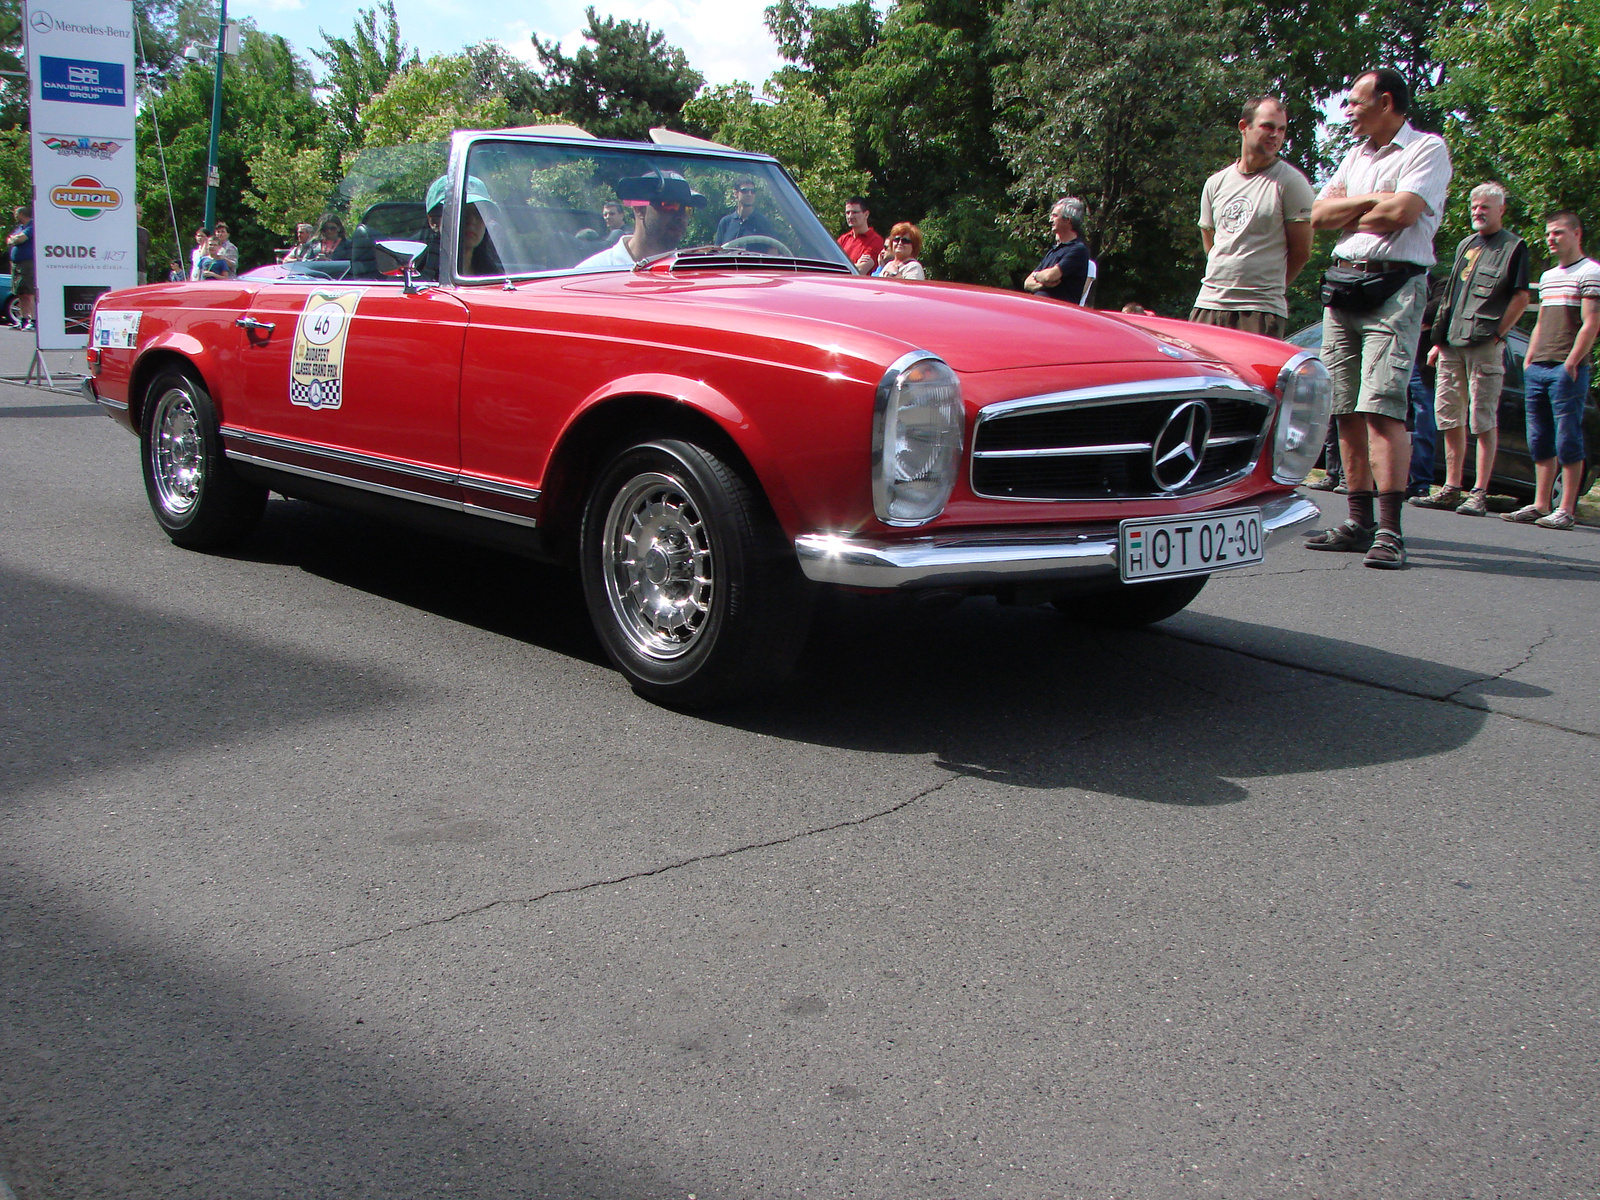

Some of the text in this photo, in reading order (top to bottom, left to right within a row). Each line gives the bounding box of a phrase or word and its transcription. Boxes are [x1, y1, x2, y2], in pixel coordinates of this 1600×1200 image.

[55, 20, 131, 38] Mercedes-Benz
[43, 82, 124, 95] DANUBIUS HOTELS
[69, 92, 100, 100] GROUP
[55, 192, 117, 204] HUNOIL
[44, 245, 97, 258] SOLIDE
[314, 311, 332, 336] 46
[305, 348, 330, 362] BUDAPEST
[295, 362, 339, 378] CLASSIC GRAND PRIX
[1199, 518, 1258, 563] 02-30
[1130, 552, 1143, 572] H
